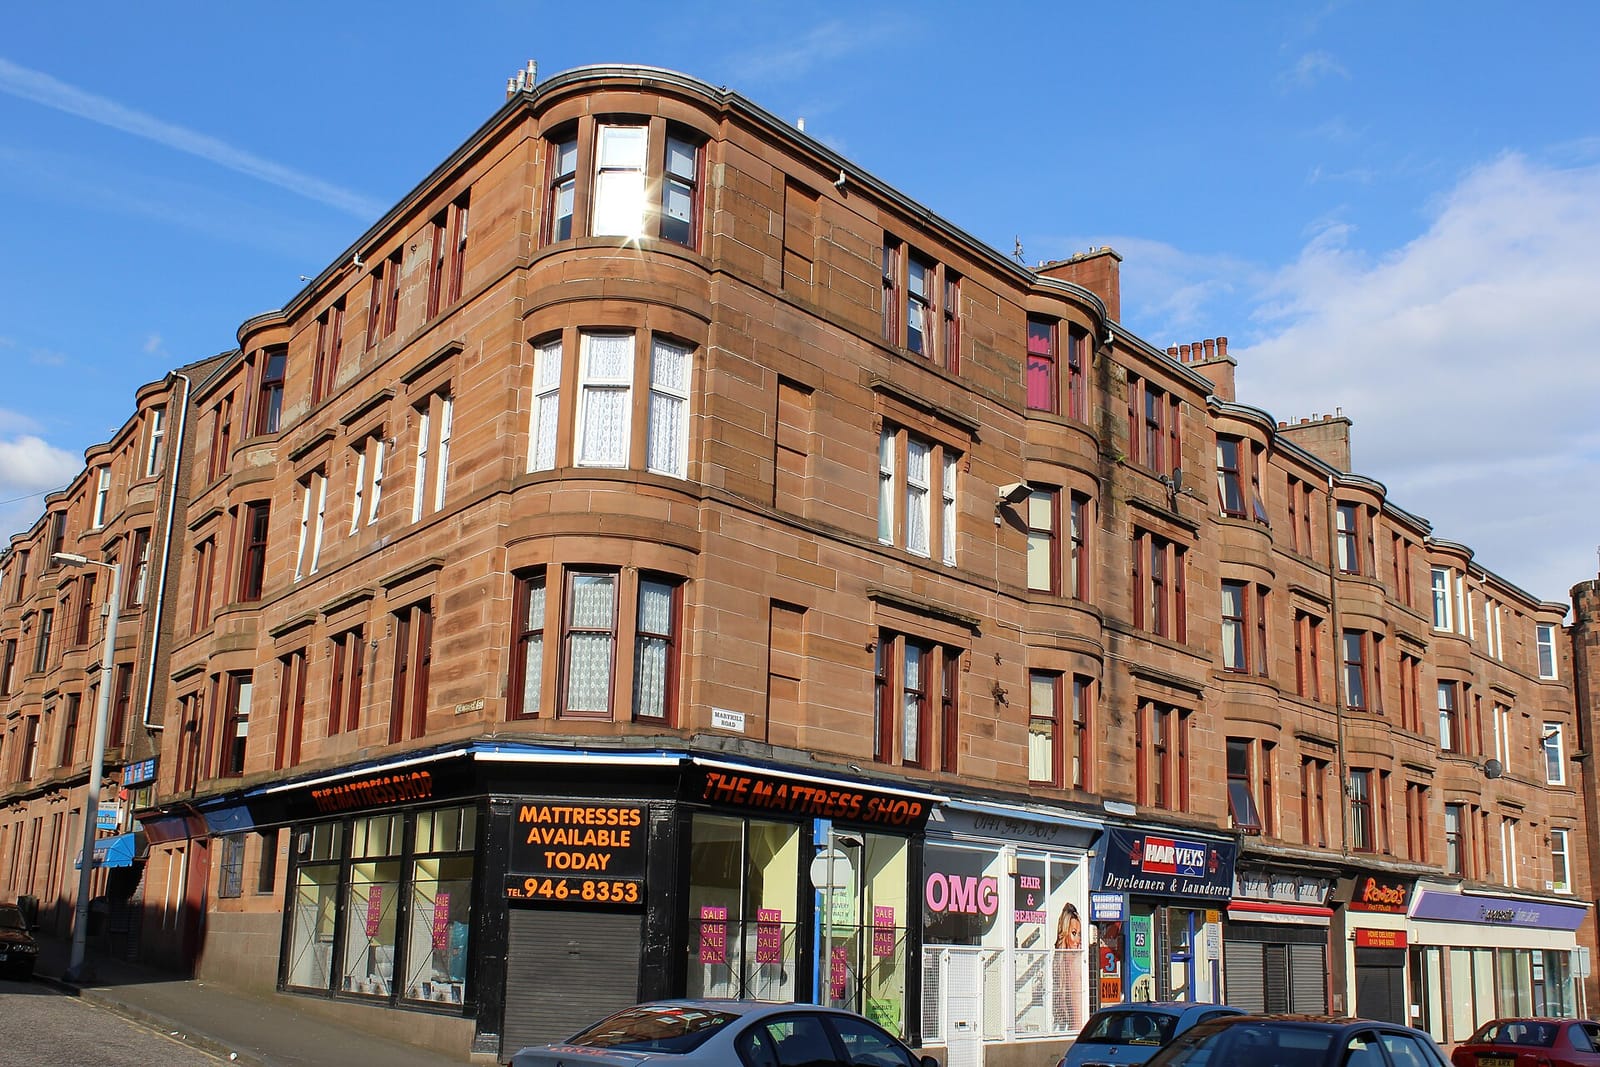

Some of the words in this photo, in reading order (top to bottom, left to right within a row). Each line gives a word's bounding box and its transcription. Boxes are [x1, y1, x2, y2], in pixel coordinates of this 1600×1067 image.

[714, 711, 743, 721] MARYHILL
[721, 720, 737, 728] ROAD
[312, 786, 340, 812] THE
[334, 776, 398, 810] MATTRESS
[391, 770, 434, 803] SHOP
[704, 772, 751, 804] THE
[750, 779, 864, 820] MATTRESS
[862, 796, 923, 826] SHOP
[519, 805, 641, 826] MATTRESSES
[526, 827, 631, 847] AVAILABLE
[1145, 843, 1204, 868] HARVEYS
[544, 851, 611, 871] TODAY
[1020, 876, 1041, 889] HAIR
[1105, 872, 1166, 892] Drycleaners
[1170, 879, 1179, 892] &
[1182, 879, 1231, 896] Launderers
[371, 889, 381, 897] SALE
[507, 888, 525, 897] TEL.
[523, 878, 638, 902] 946-8353
[925, 872, 999, 916] OMG
[436, 897, 448, 906] SALE
[1026, 893, 1034, 906] &
[369, 901, 380, 909] SALE
[368, 912, 379, 921] SALE
[435, 910, 447, 919] SALE
[703, 910, 724, 919] SALE
[760, 912, 779, 922] SALE
[875, 910, 893, 919] SALE
[1015, 910, 1046, 924] BEAUTY
[367, 925, 378, 934] SALE
[434, 922, 446, 932] SALE
[703, 924, 723, 933] SALE
[875, 921, 892, 930] SALE
[759, 927, 778, 935] SALE
[433, 936, 445, 945] SALE
[702, 937, 723, 947] SALE
[874, 932, 892, 942] SALE
[1135, 934, 1145, 946] 25
[758, 938, 777, 948] SALE
[831, 950, 845, 960] ALE
[874, 945, 891, 955] SALE
[1133, 947, 1149, 958] items
[702, 951, 723, 960] SALE
[758, 951, 776, 961] SALE
[831, 963, 844, 972] ALE
[1105, 953, 1115, 972] 3
[831, 975, 844, 985] ALE
[830, 988, 844, 997] ALE
[1101, 981, 1119, 999] £10.99
